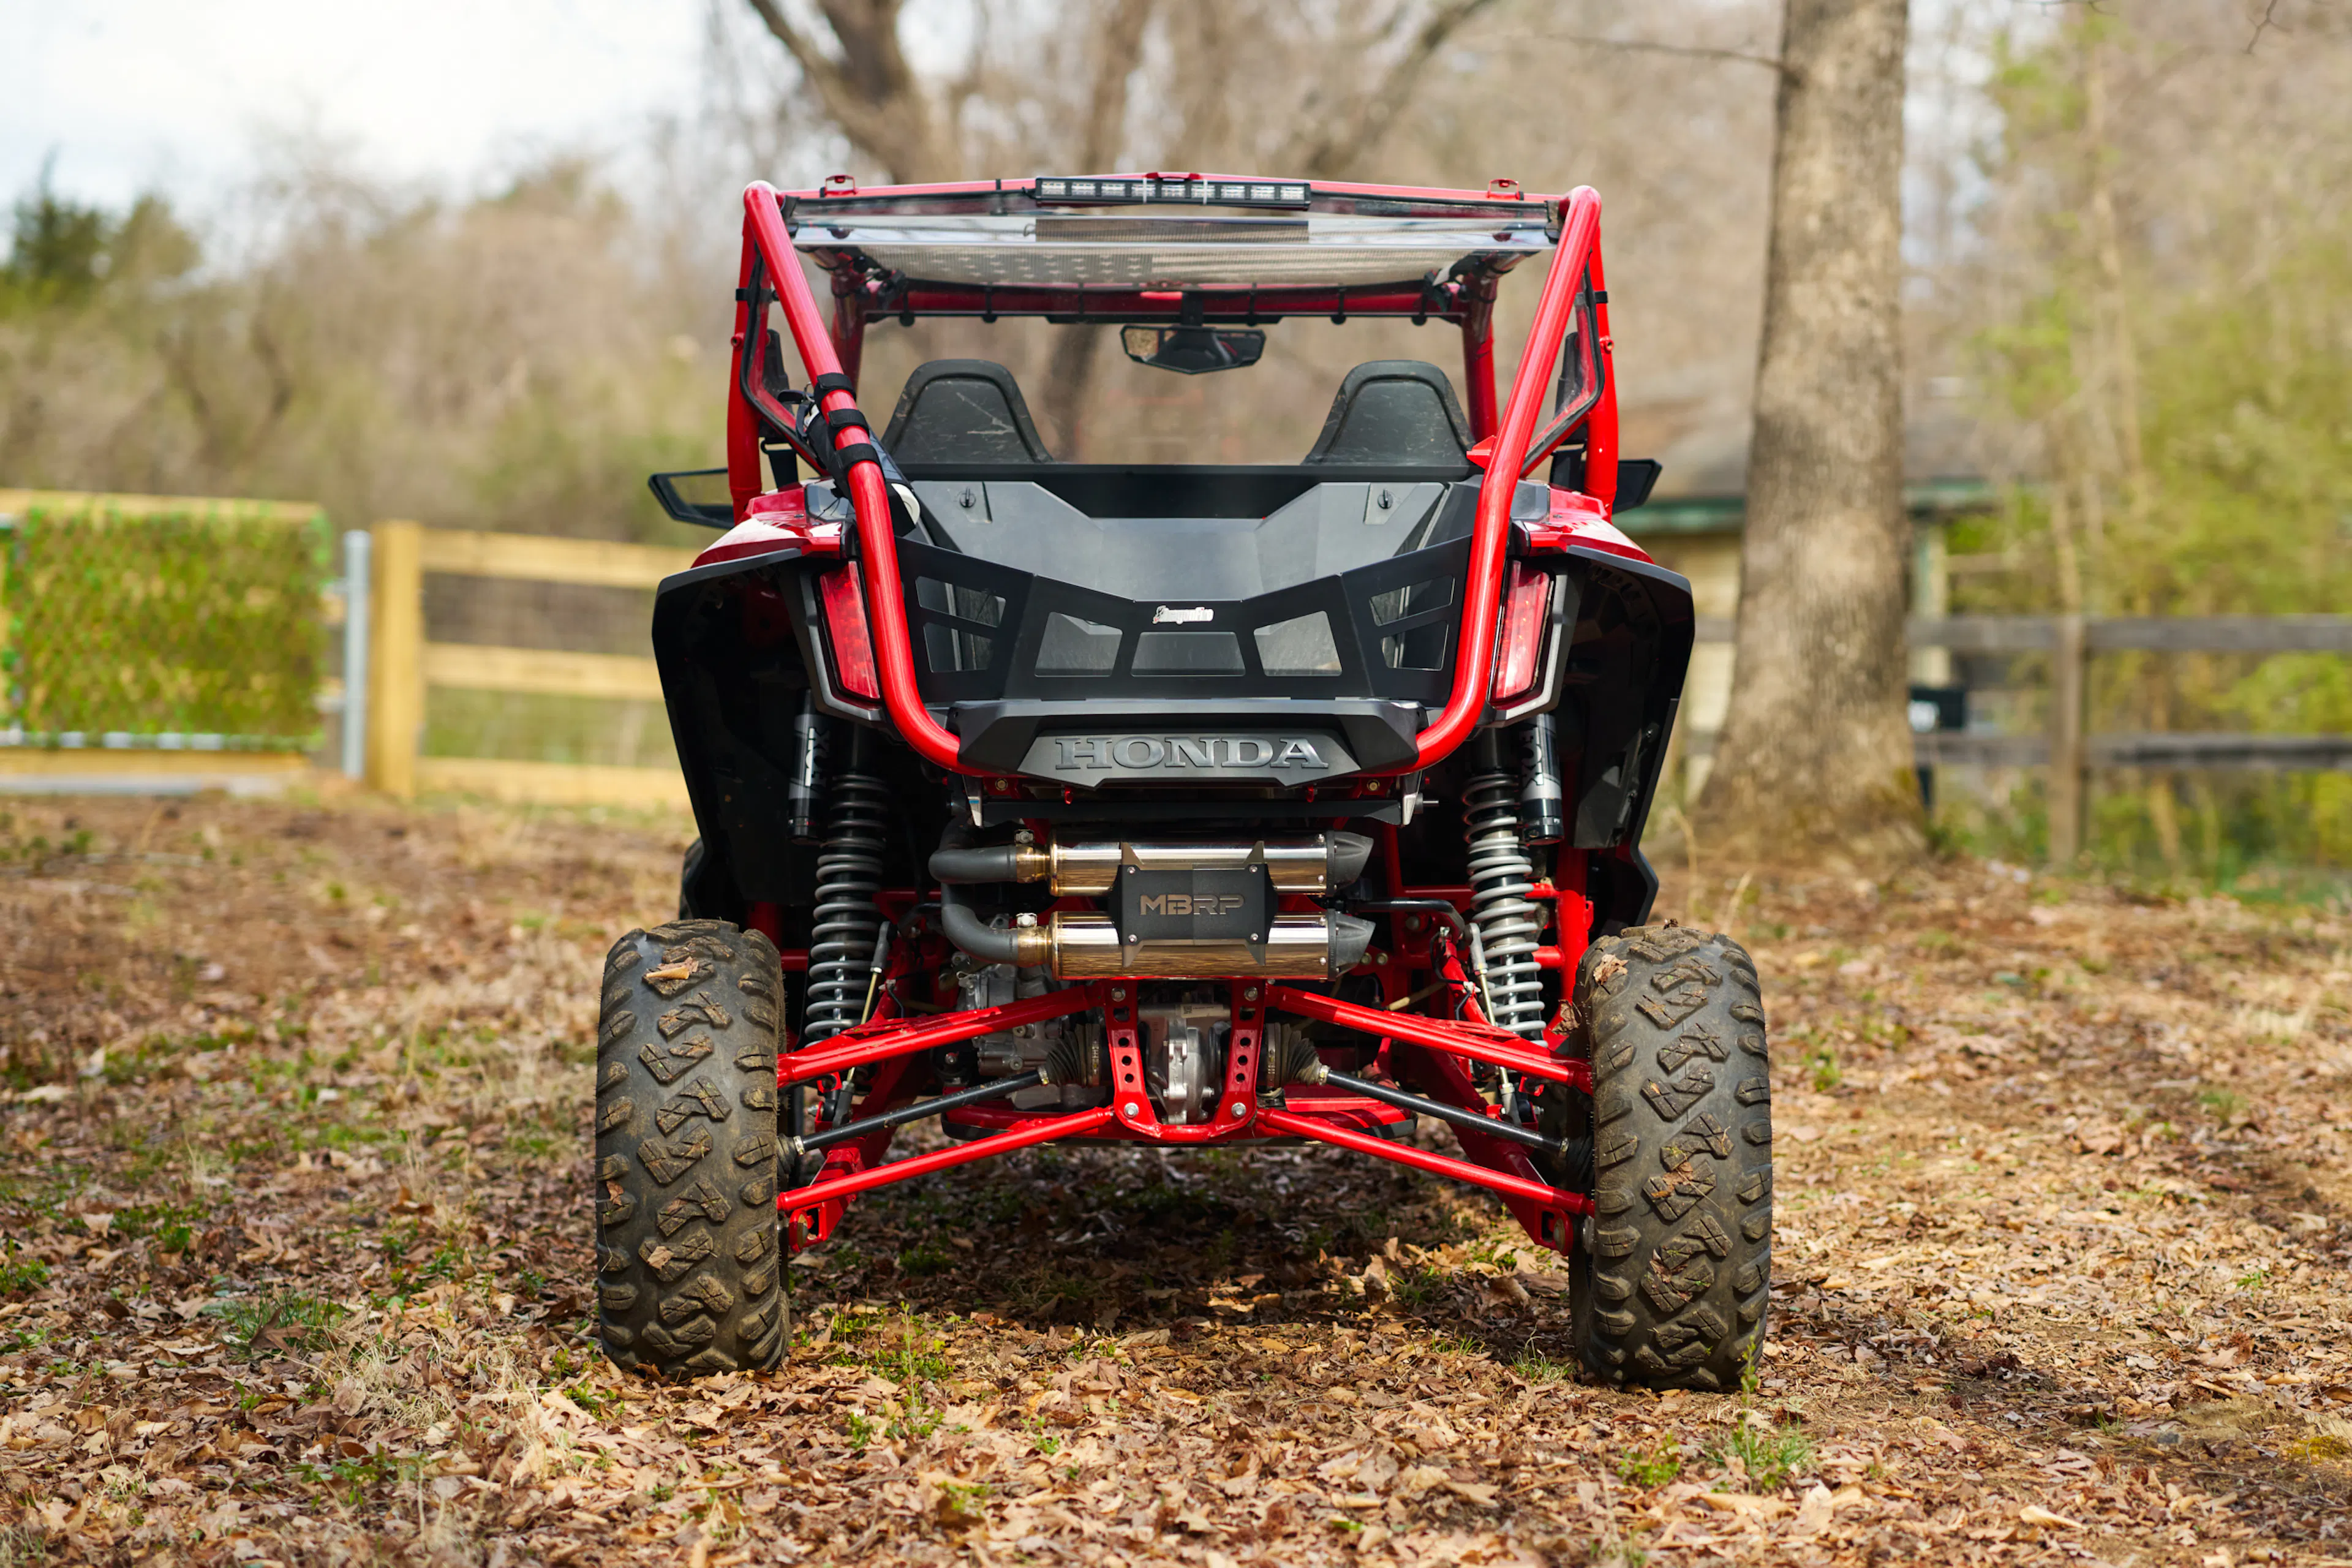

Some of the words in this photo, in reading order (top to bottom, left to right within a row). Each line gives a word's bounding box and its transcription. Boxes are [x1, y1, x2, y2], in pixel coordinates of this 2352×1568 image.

[804, 726, 831, 788] FOX
[1055, 736, 1329, 770] HONDA
[1518, 726, 1544, 789] FOX
[1140, 894, 1245, 916] MBRP
